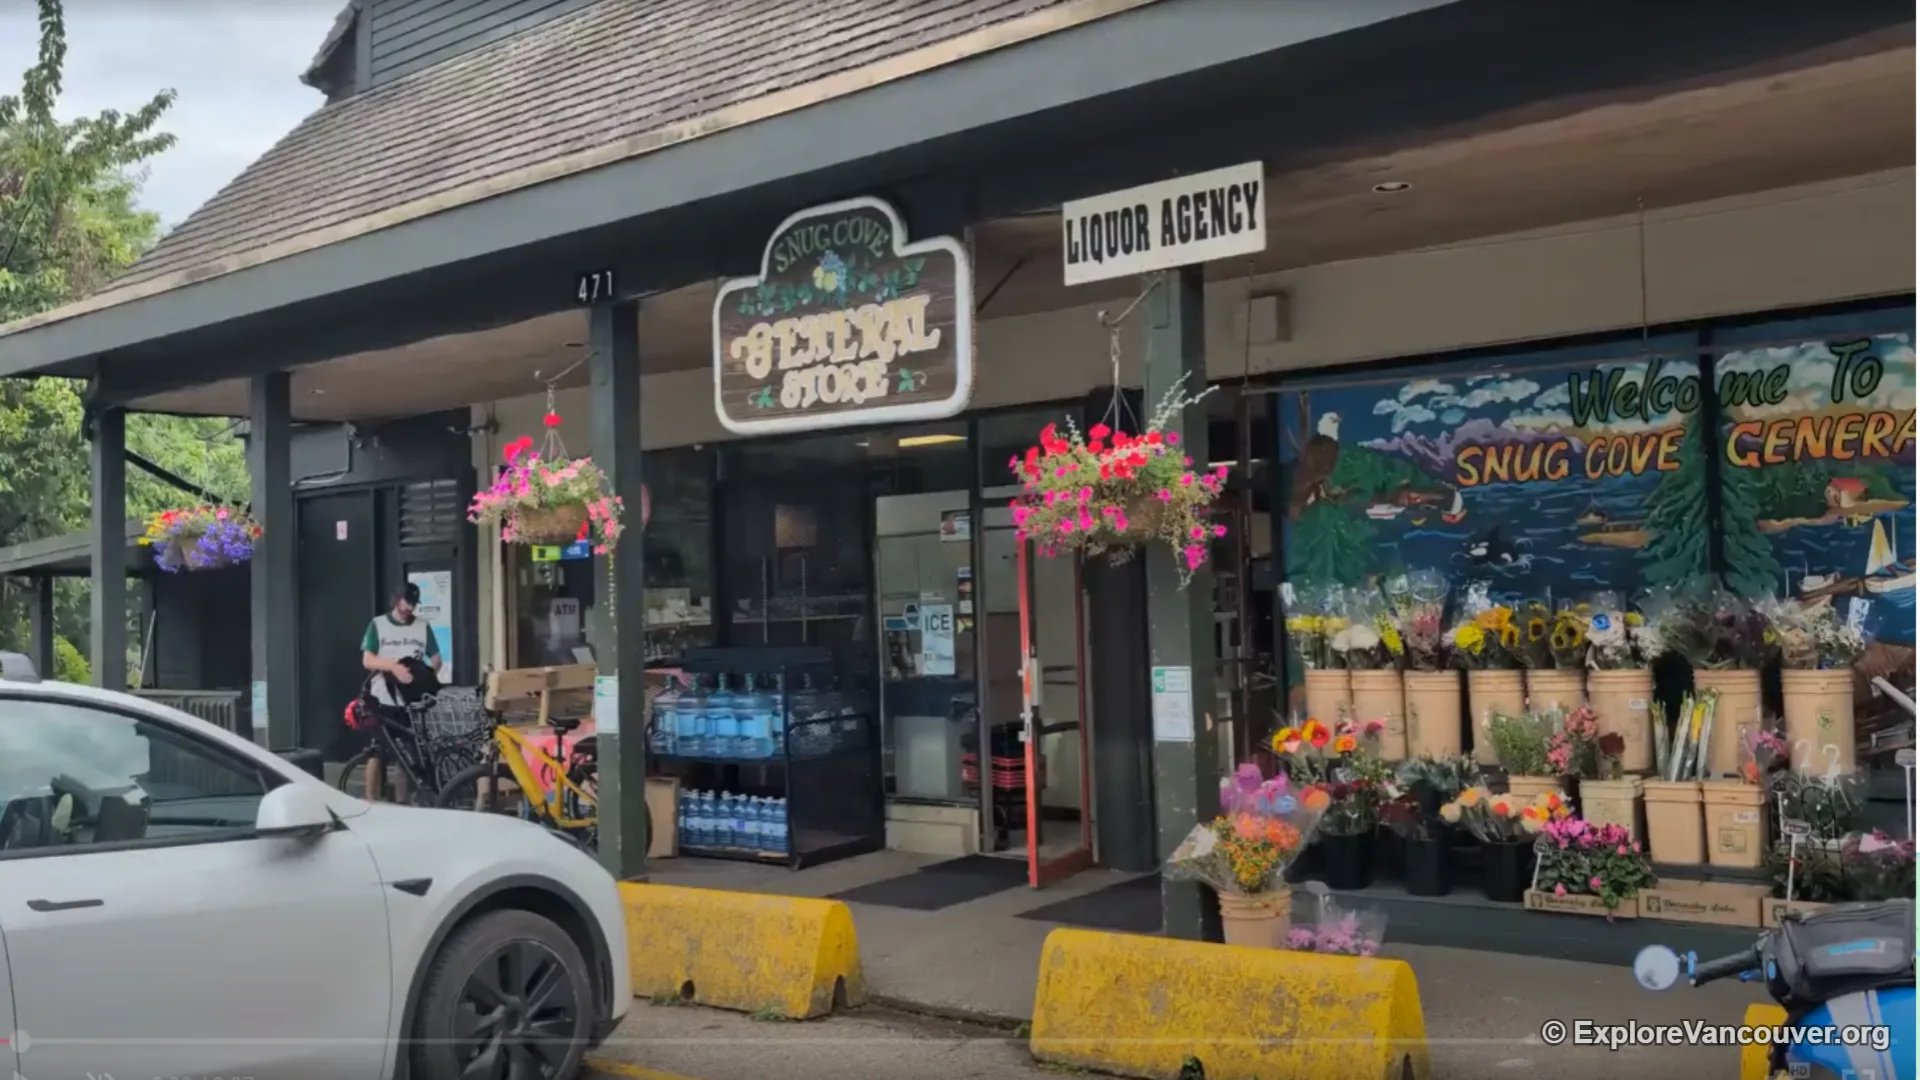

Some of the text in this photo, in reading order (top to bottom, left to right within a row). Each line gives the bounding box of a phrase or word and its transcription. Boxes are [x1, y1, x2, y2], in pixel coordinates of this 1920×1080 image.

[773, 217, 890, 272] SNUG COVE
[1066, 180, 1259, 264] LIQUOR AGENCY
[579, 271, 613, 302] 471
[730, 294, 941, 379] GENERAL
[780, 359, 889, 408] STORE
[1828, 338, 1884, 404] To
[1455, 427, 1685, 488] SNUG COVE
[555, 604, 577, 616] ATM
[924, 613, 951, 631] ICE
